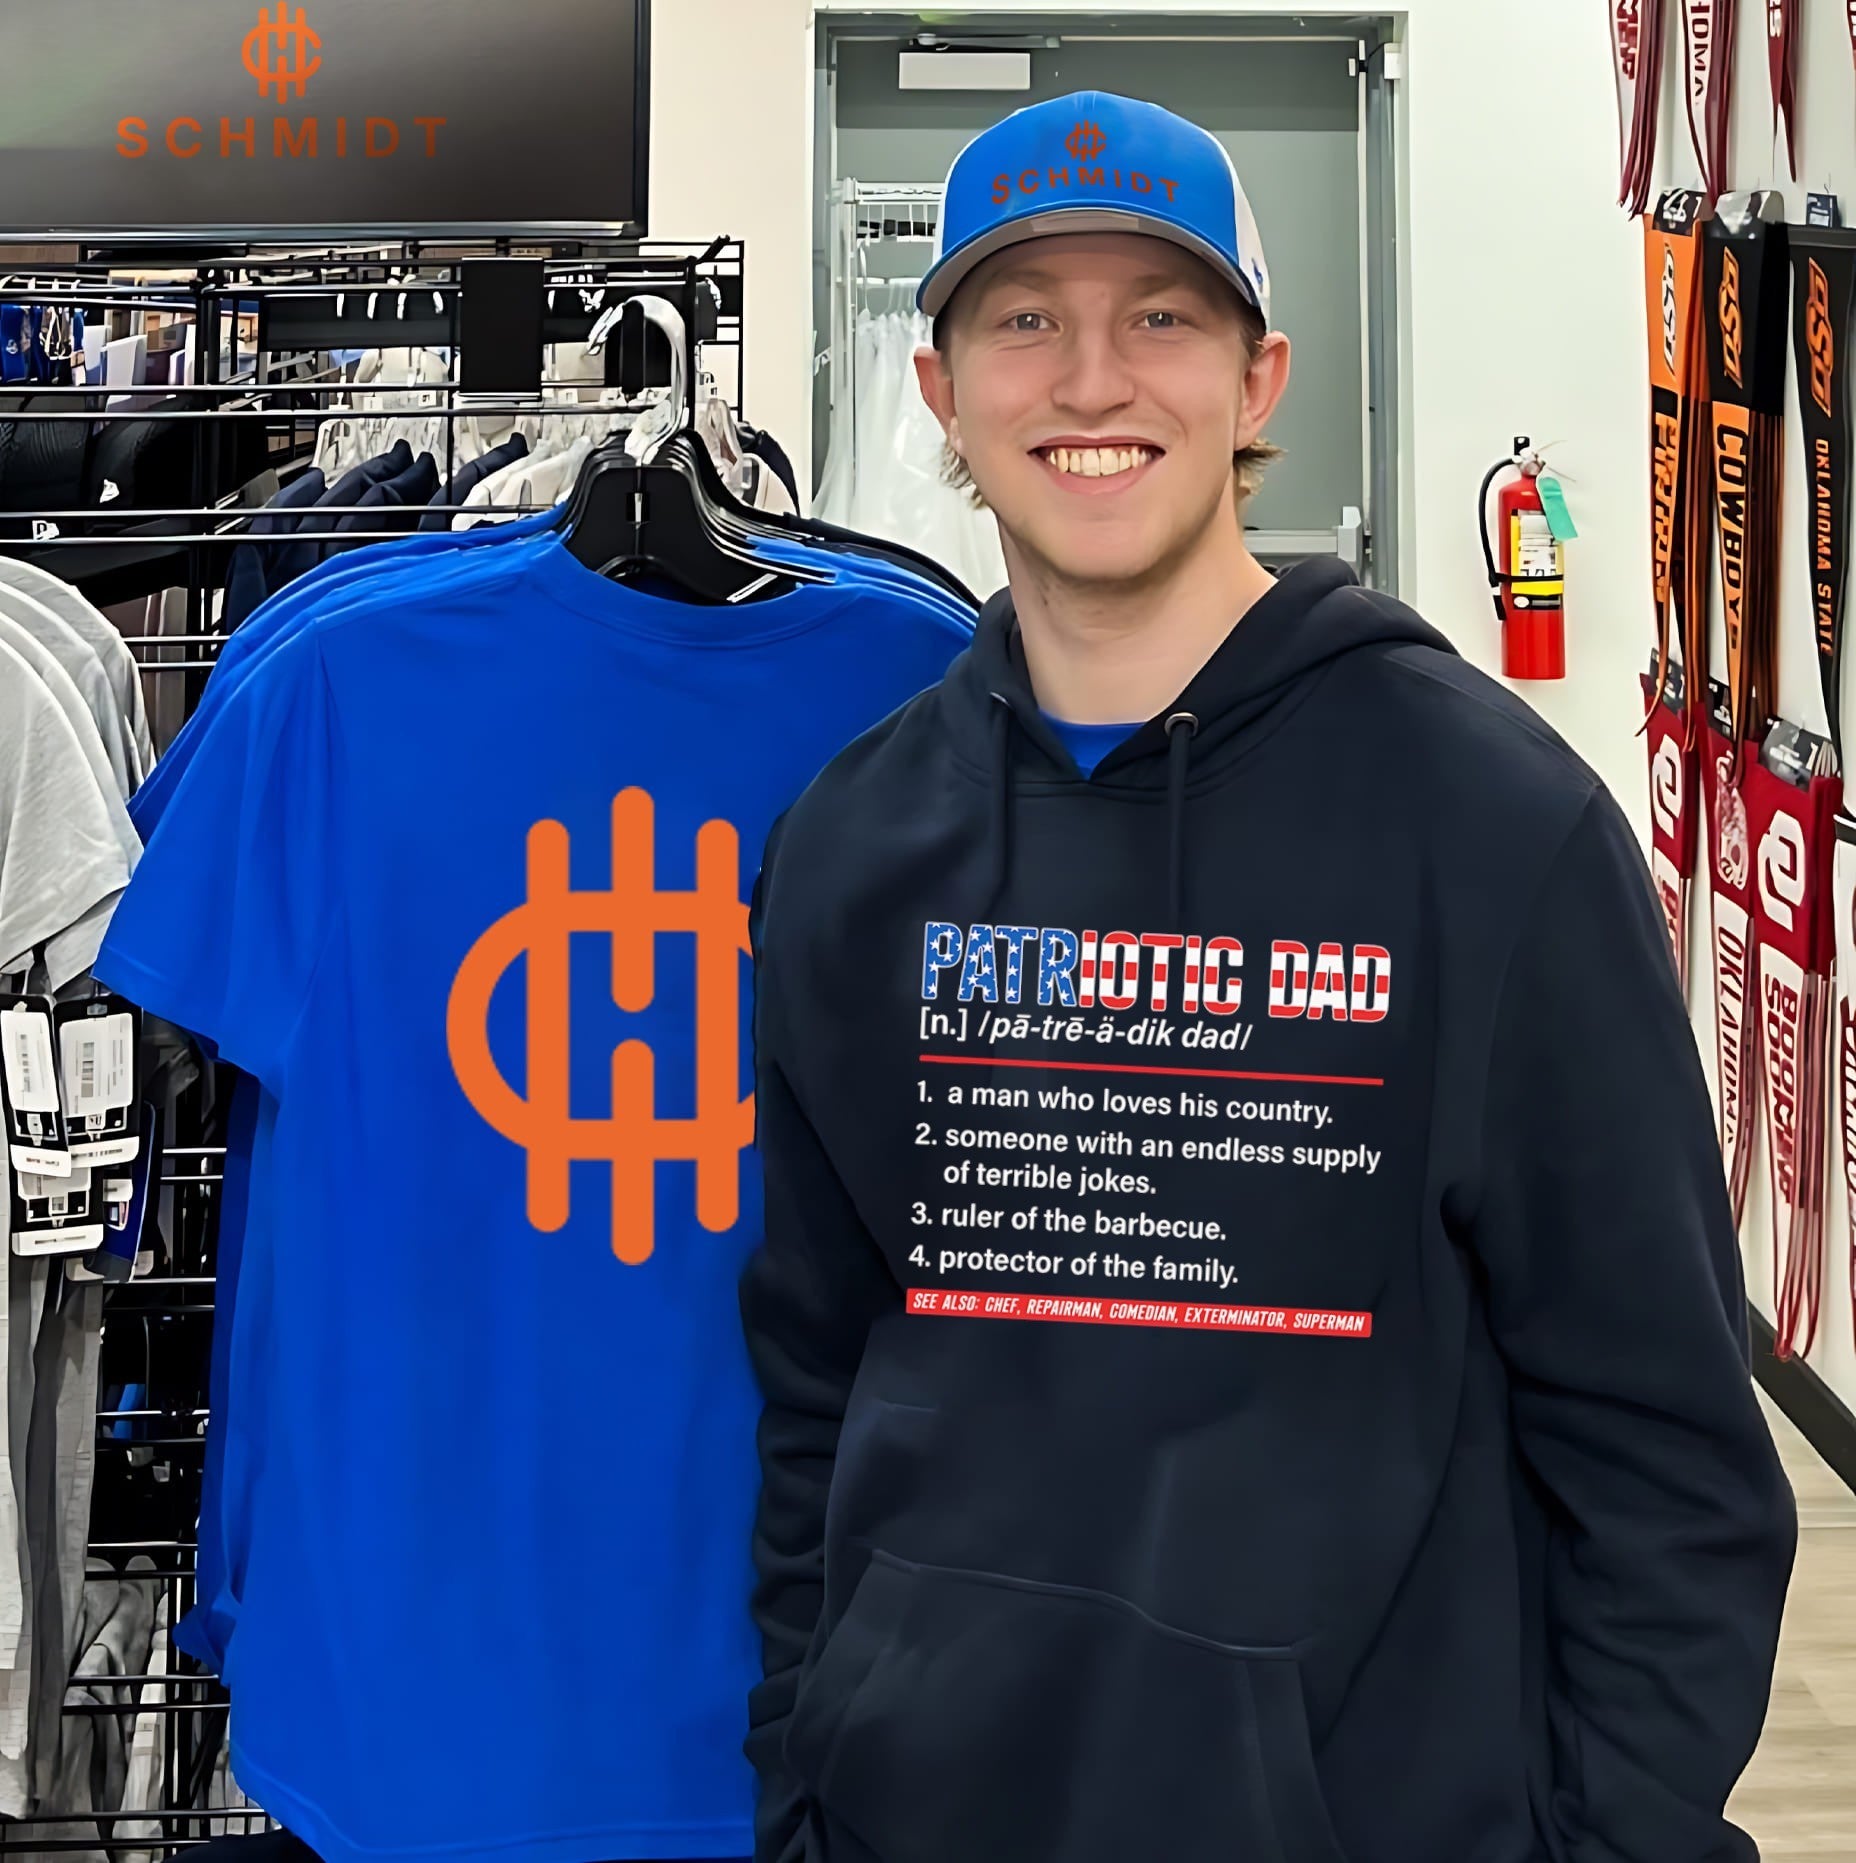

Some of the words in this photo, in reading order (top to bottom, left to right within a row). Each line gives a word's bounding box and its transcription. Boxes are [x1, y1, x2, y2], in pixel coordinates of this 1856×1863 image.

[116, 116, 447, 158] SCHMIDT
[991, 167, 1179, 204] SCHMIDT
[1815, 438, 1832, 570] OKLAHOMA
[920, 920, 1244, 1015] PATRIOTIC
[1267, 939, 1392, 1024] DAD
[919, 1005, 968, 1042] [n.]
[1181, 1020, 1254, 1051] dad/
[1717, 926, 1747, 1145] OKLAHOMA
[917, 1079, 933, 1103] 1.
[947, 1086, 963, 1105] a
[971, 1087, 1029, 1108] man
[1037, 1085, 1095, 1112] who
[1103, 1087, 1172, 1116] loves
[1179, 1092, 1218, 1118] his
[1225, 1099, 1333, 1130] country.
[914, 1122, 938, 1146] 2.
[945, 1128, 1069, 1153] someone
[1076, 1130, 1133, 1156] with
[1140, 1138, 1174, 1158] an
[1181, 1136, 1285, 1164] endless
[1292, 1143, 1382, 1175] supply
[943, 1159, 971, 1185] of
[975, 1162, 1072, 1190] terrible
[1077, 1166, 1156, 1197] jokes.
[910, 1201, 933, 1225] 3.
[941, 1202, 1005, 1229] ruler
[1011, 1206, 1039, 1231] of
[1043, 1207, 1087, 1234] the
[1094, 1209, 1226, 1241] barbecue.
[908, 1244, 931, 1268] 4.
[939, 1248, 1064, 1275] protector
[1070, 1251, 1097, 1276] of
[1102, 1252, 1146, 1279] the
[1152, 1254, 1239, 1289] family.
[912, 1292, 937, 1310] SEE
[941, 1294, 980, 1312] ALSO:
[984, 1296, 1021, 1315] CHEF,
[1026, 1298, 1103, 1320] REPAIRMAN,
[1109, 1302, 1179, 1324] COMEDIAN,
[1183, 1306, 1287, 1329] EXTERMINATOR,
[1293, 1312, 1365, 1332] SUPERMAN
